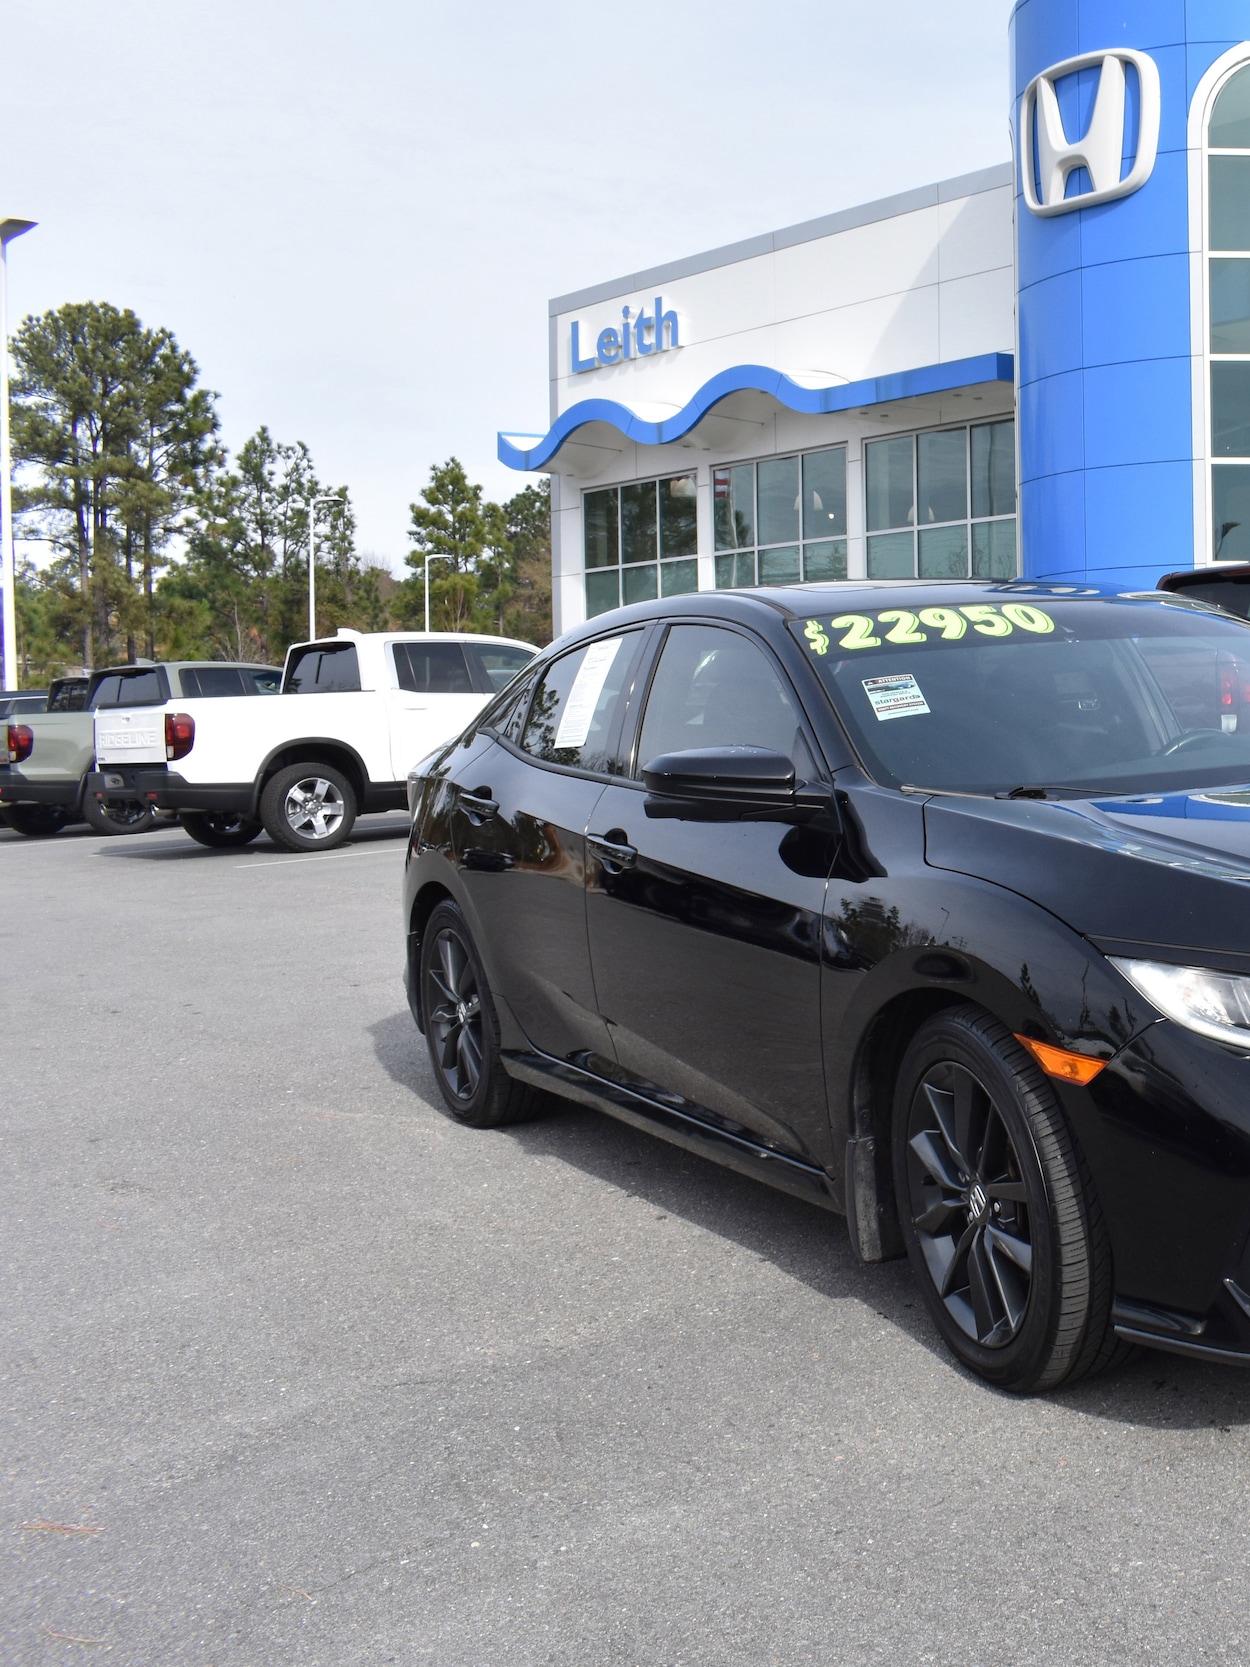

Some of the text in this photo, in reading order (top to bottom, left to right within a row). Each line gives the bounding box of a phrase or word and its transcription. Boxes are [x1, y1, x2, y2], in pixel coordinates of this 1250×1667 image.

[570, 296, 679, 373] Leith
[803, 603, 1055, 656] $22950
[98, 731, 158, 748] RIDGELINE
